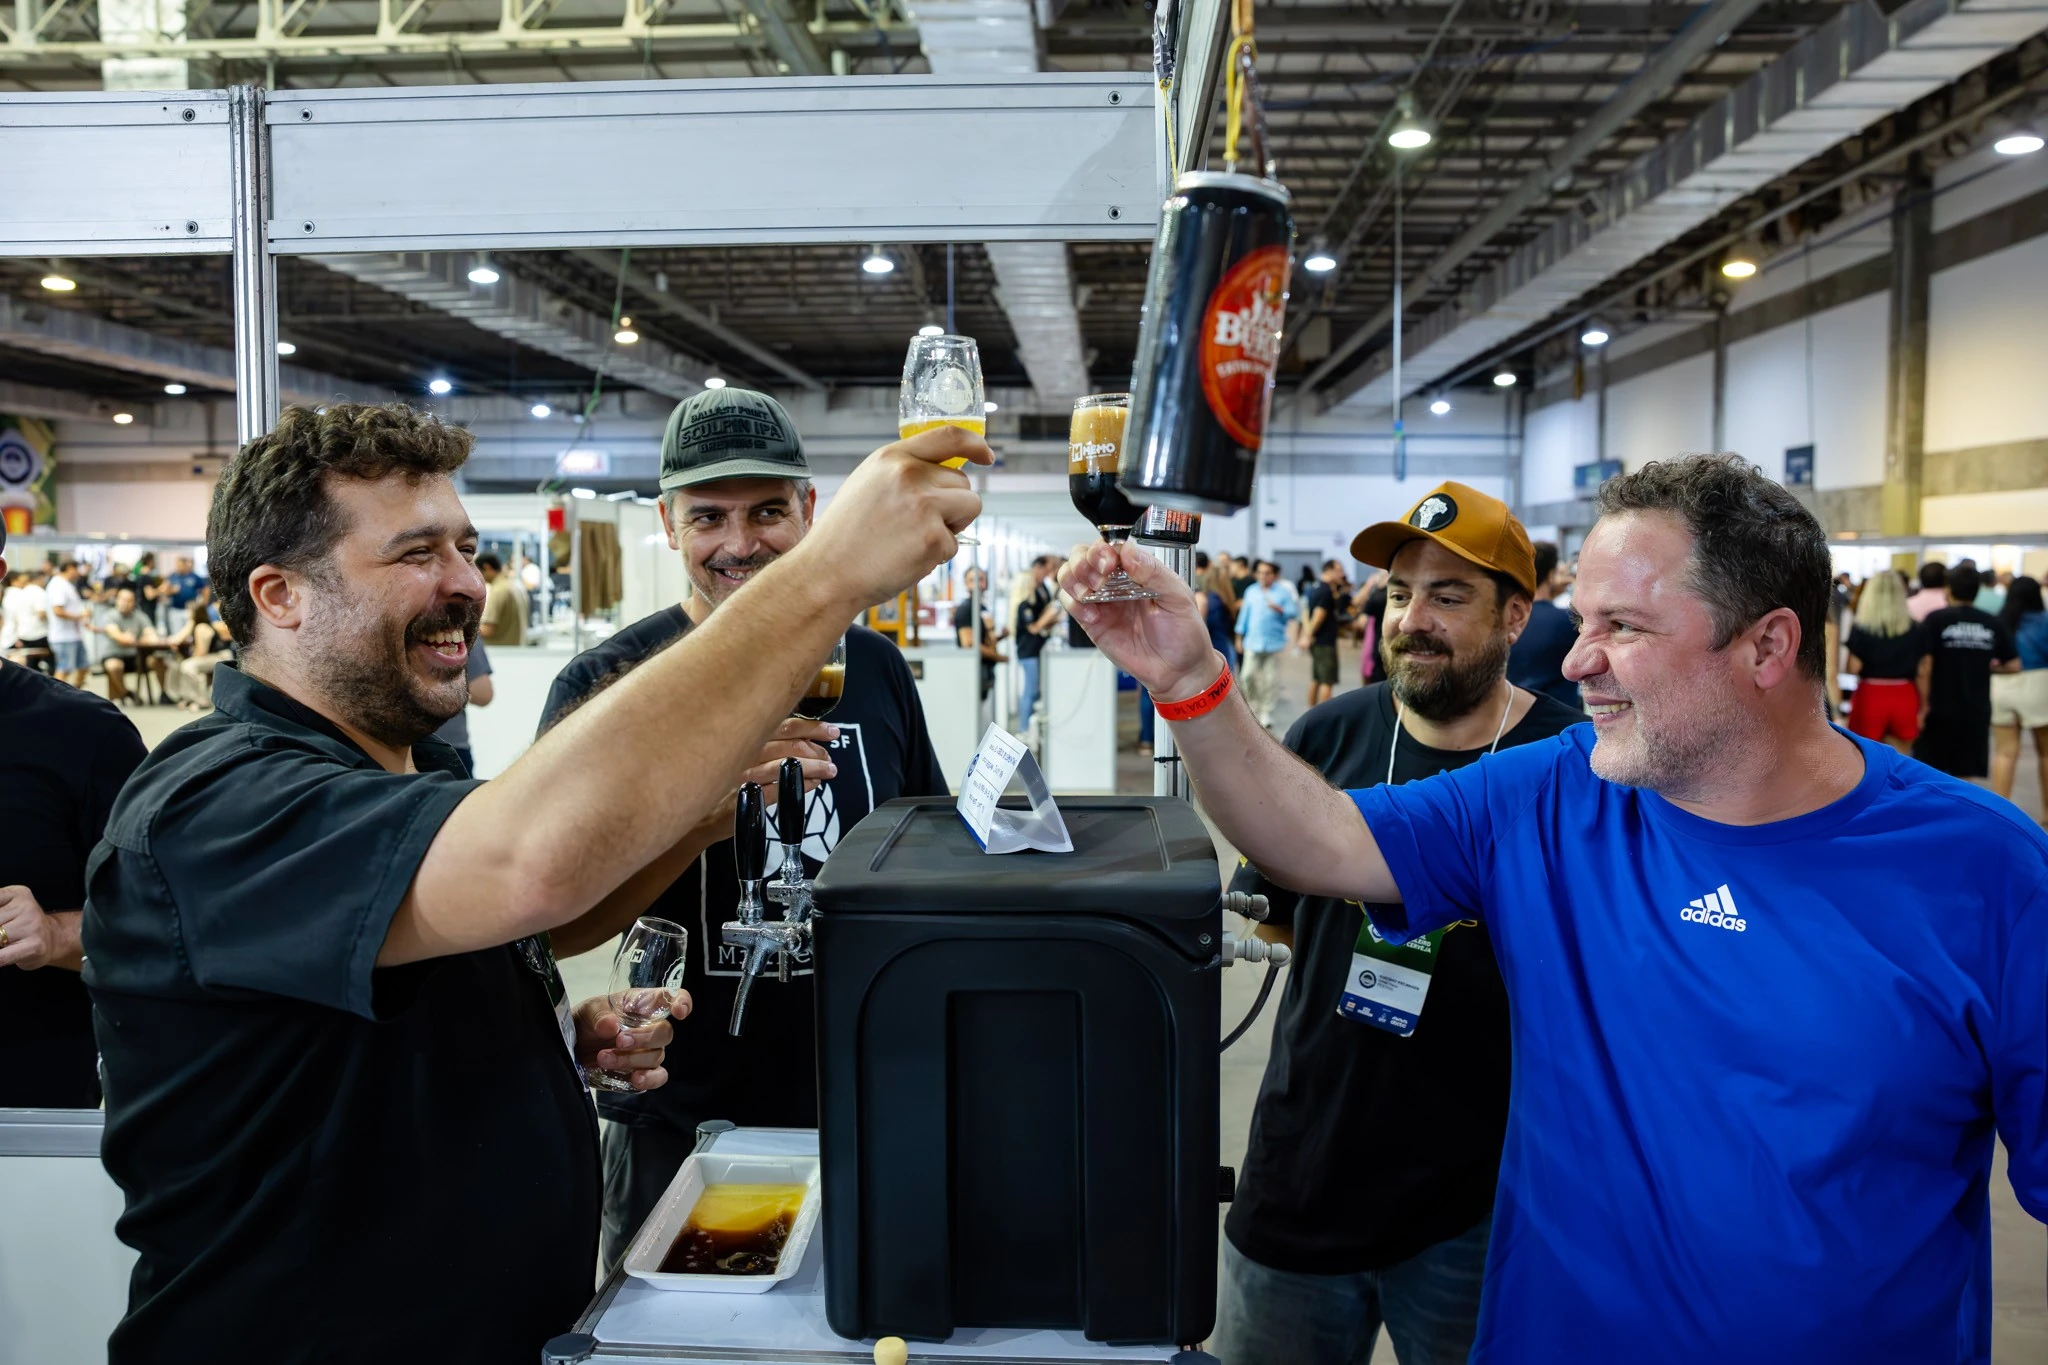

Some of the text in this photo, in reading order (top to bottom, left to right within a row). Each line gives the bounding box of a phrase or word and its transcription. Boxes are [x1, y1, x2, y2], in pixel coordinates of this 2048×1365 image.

[691, 406, 768, 424] BALLAST POINT
[682, 418, 783, 445] SCULPIN IPA
[700, 439, 753, 453] BREWING
[1083, 443, 1116, 456] MEMO
[1173, 705, 1187, 715] 14
[1187, 698, 1207, 711] DIA
[1680, 907, 1747, 932] adidas
[1406, 941, 1432, 954] CERVEJA
